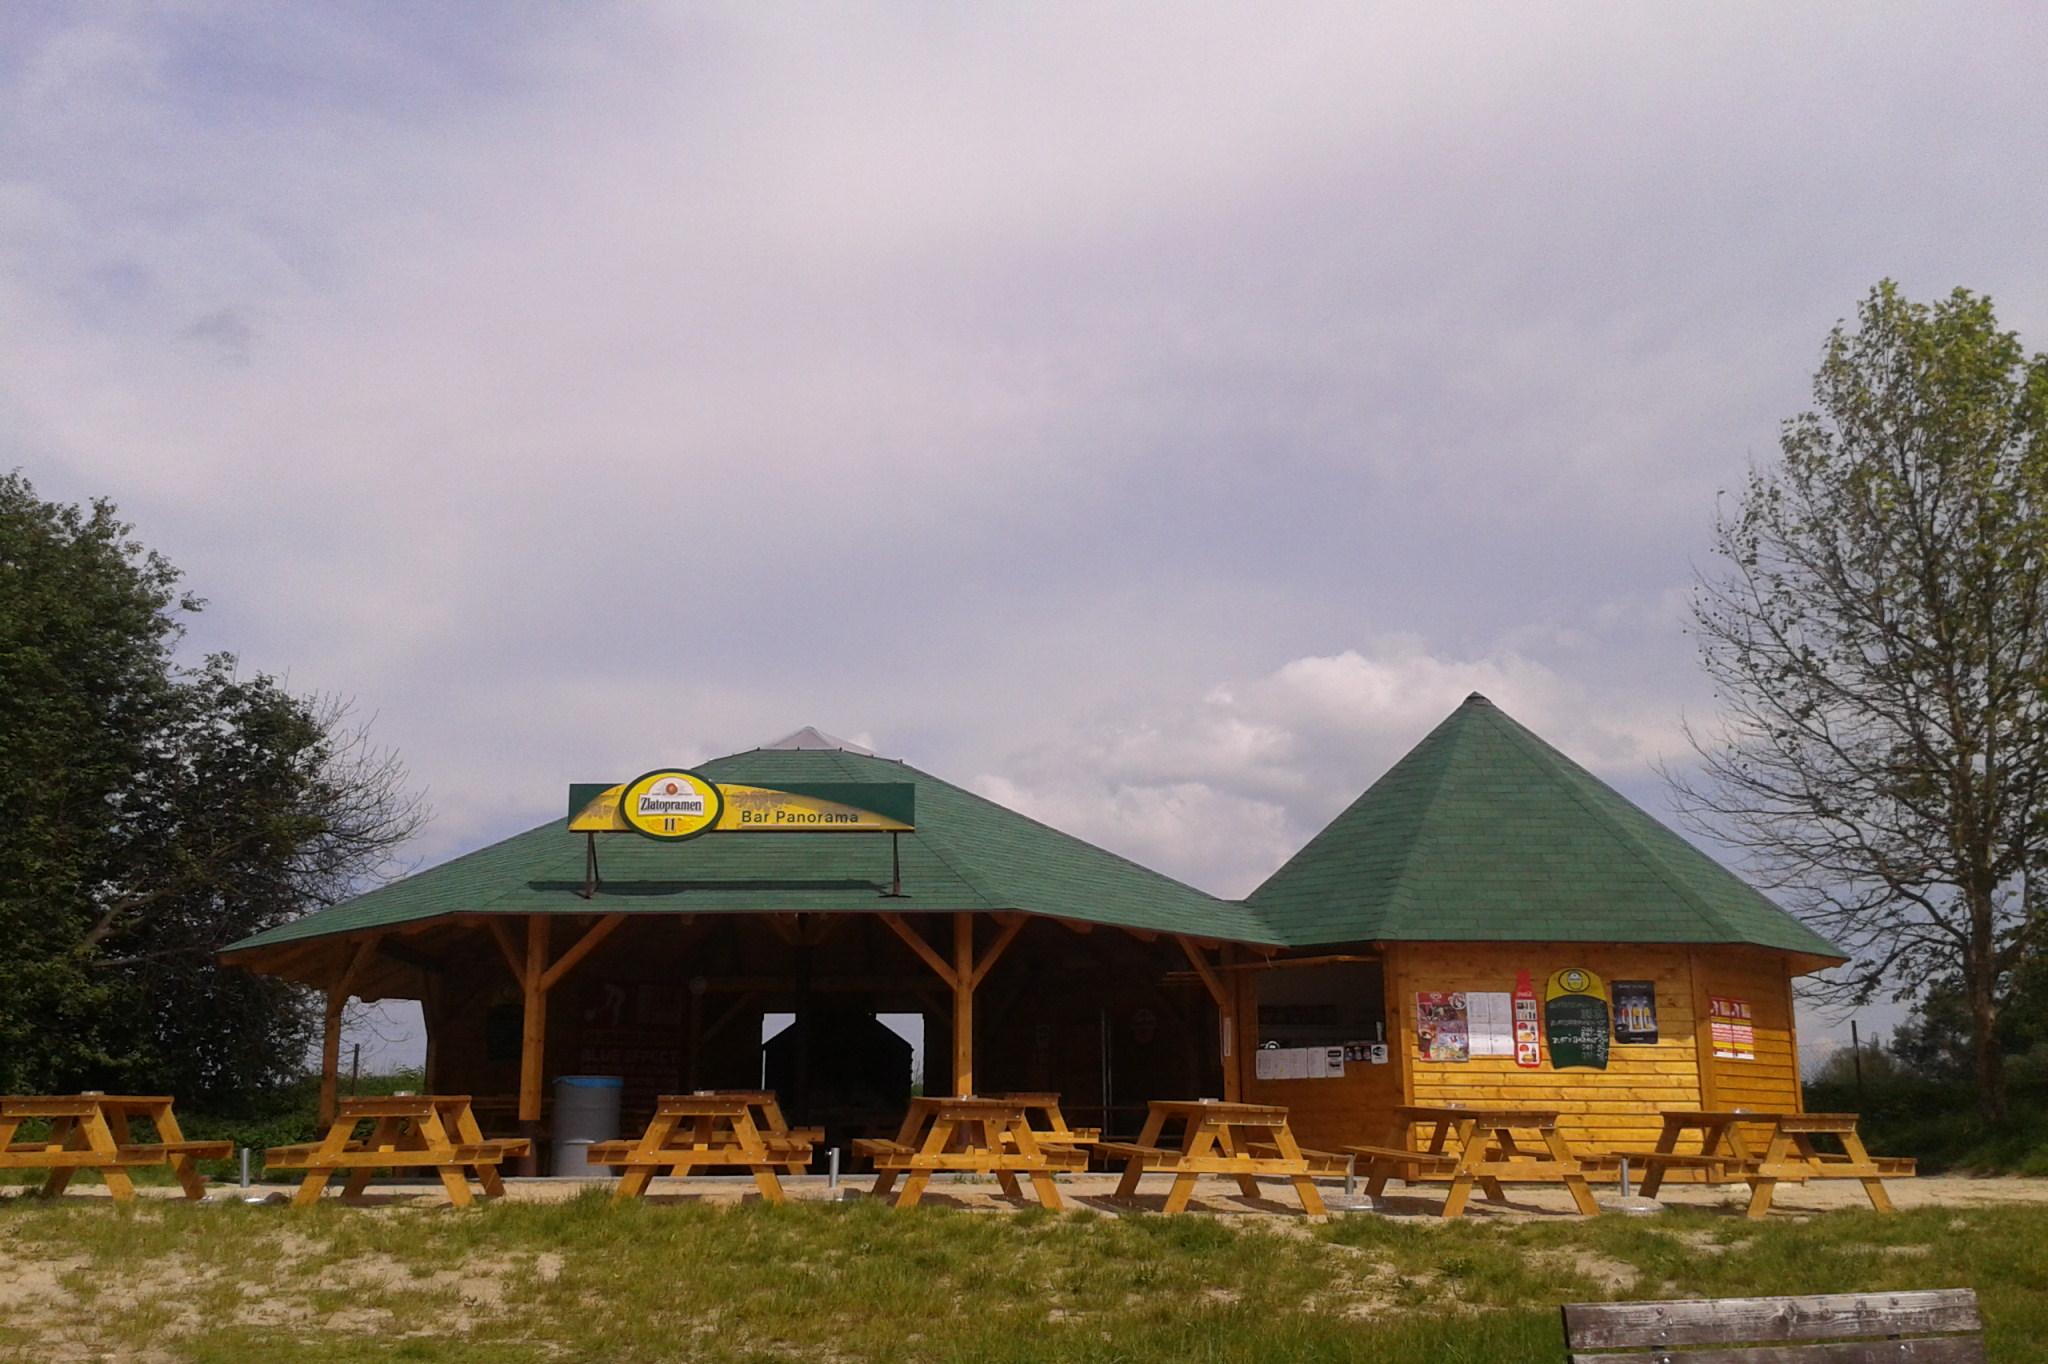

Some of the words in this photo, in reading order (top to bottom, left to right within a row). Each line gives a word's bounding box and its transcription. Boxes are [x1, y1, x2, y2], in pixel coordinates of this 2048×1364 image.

[640, 797, 702, 812] Zlatopramen
[742, 810, 769, 823] Bar
[776, 810, 859, 823] Panorama
[664, 818, 676, 831] 11
